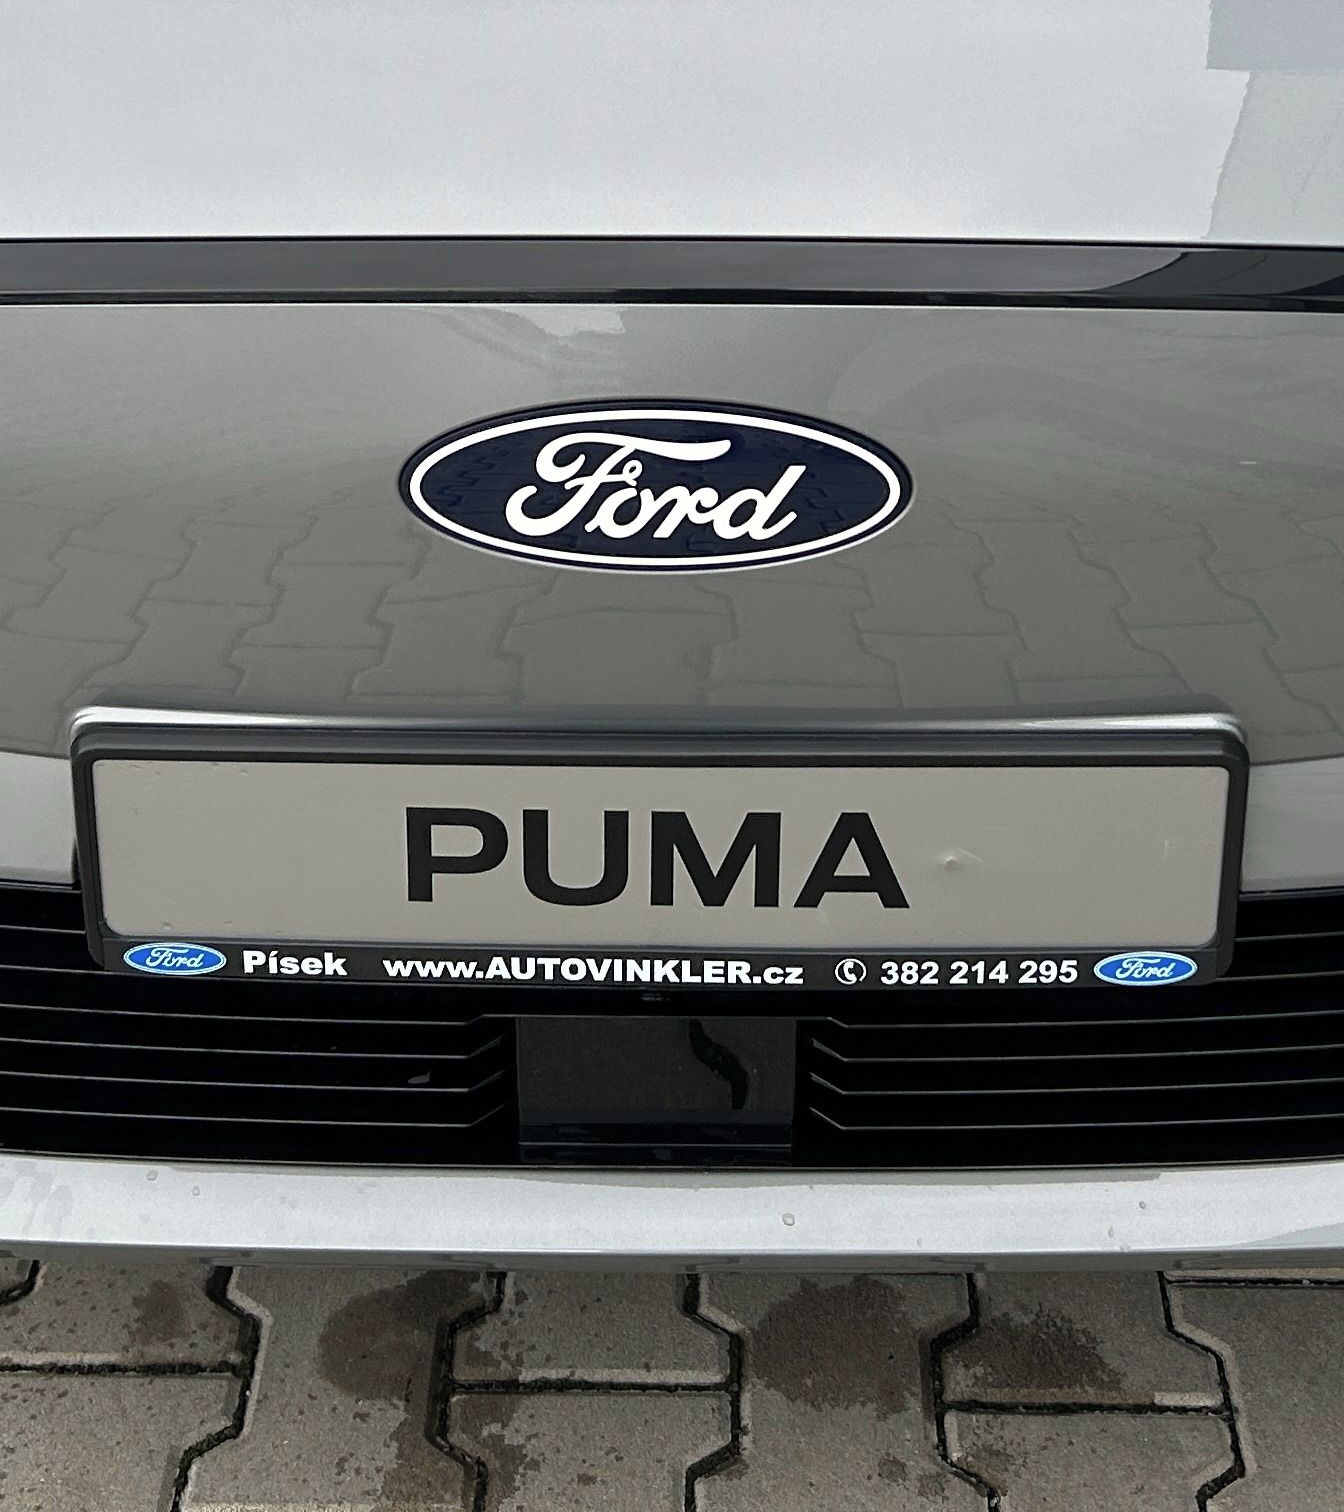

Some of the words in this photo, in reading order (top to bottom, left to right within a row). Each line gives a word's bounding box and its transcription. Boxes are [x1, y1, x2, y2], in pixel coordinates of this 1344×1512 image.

[505, 432, 807, 541] Ford
[405, 806, 910, 909] PUMA
[145, 947, 205, 968] Ford
[242, 950, 348, 977] Písek
[382, 956, 804, 986] www.AUTOVINKLER.cz
[880, 960, 940, 986] 382
[949, 960, 1009, 985] 214
[1018, 959, 1079, 985] 295
[1115, 957, 1177, 979] Ford
